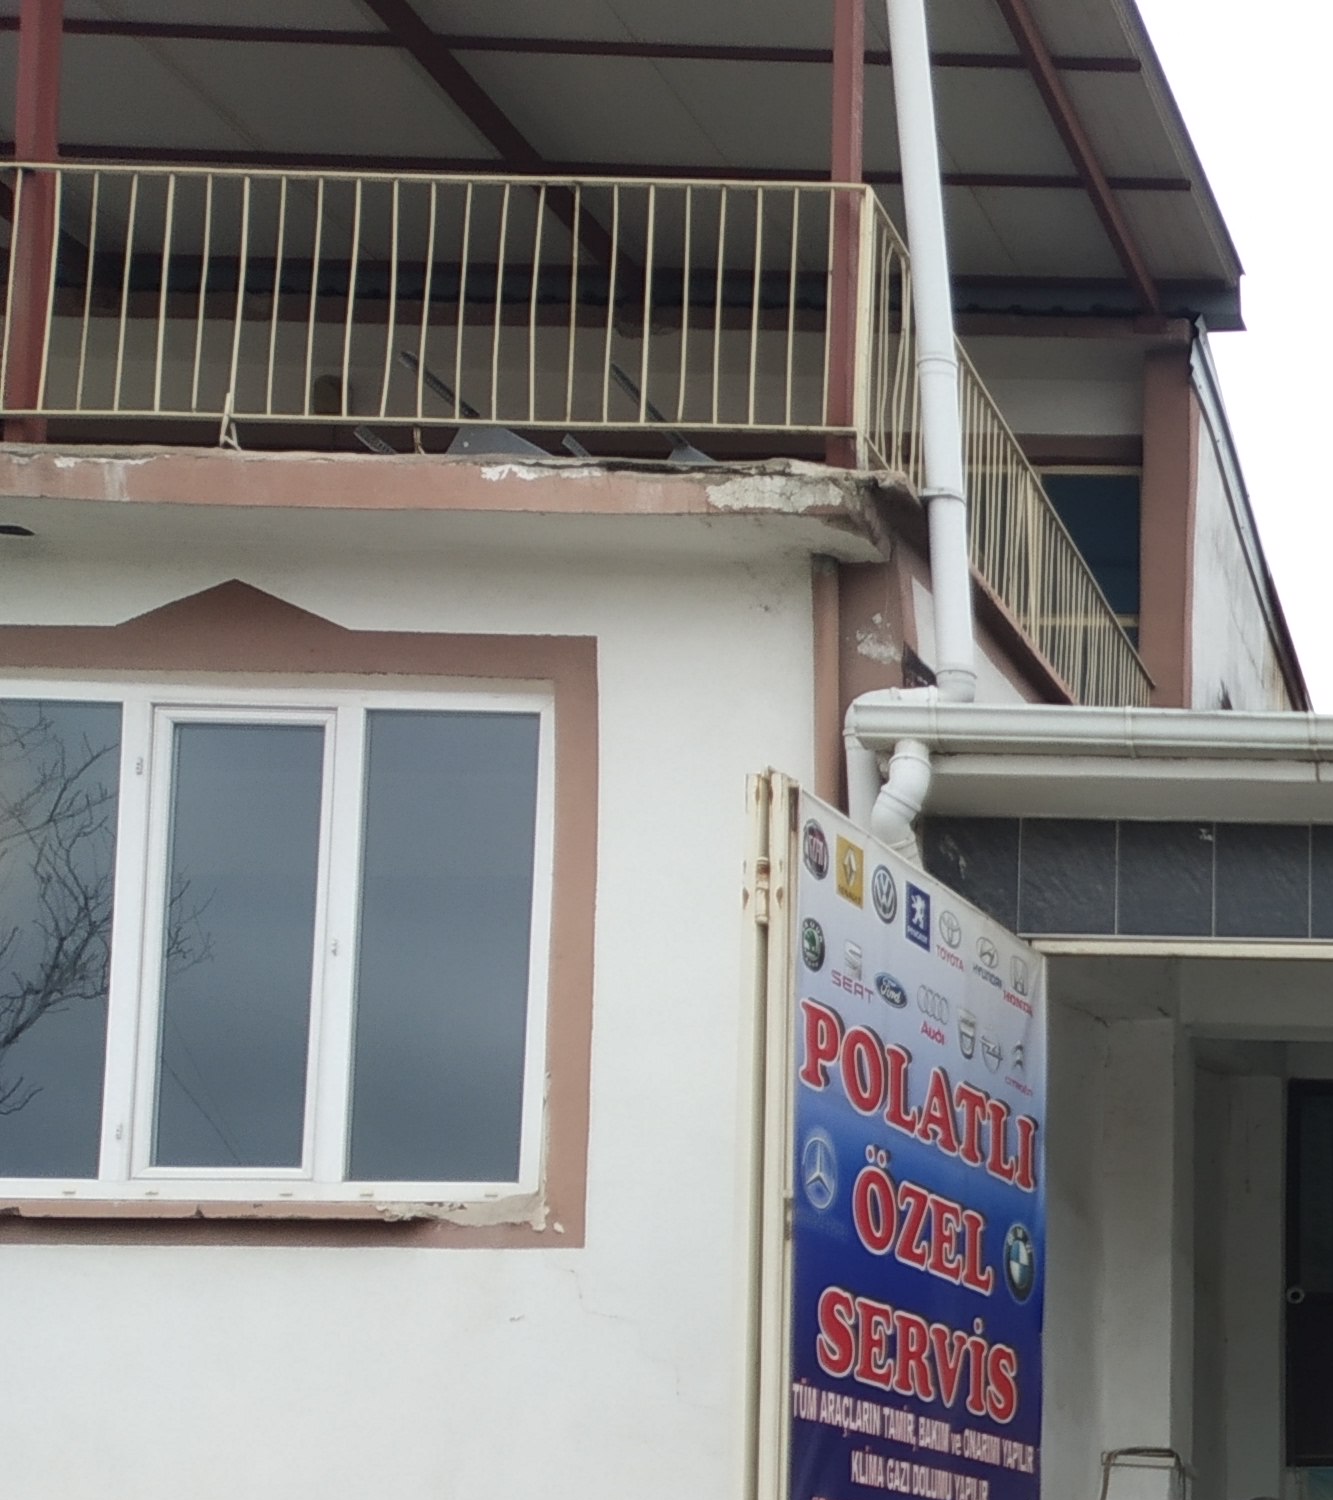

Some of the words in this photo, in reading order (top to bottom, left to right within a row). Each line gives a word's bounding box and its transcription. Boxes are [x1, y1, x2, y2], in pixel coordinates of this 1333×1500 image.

[831, 969, 874, 1003] SEAT
[936, 944, 964, 972] TOYOTA
[800, 998, 1037, 1193] POLATLI
[852, 1142, 995, 1297] ÖZEL
[816, 1286, 1018, 1424] SERVİS
[792, 1378, 817, 1421] TÜM
[819, 1391, 880, 1438] ARAÇLARIN
[919, 1416, 950, 1453] BAKIM
[963, 1428, 1001, 1466] ONARIMI
[1002, 1439, 1034, 1474] YAPILIR
[851, 1445, 884, 1488] KLİMA
[887, 1458, 910, 1493] GAZI
